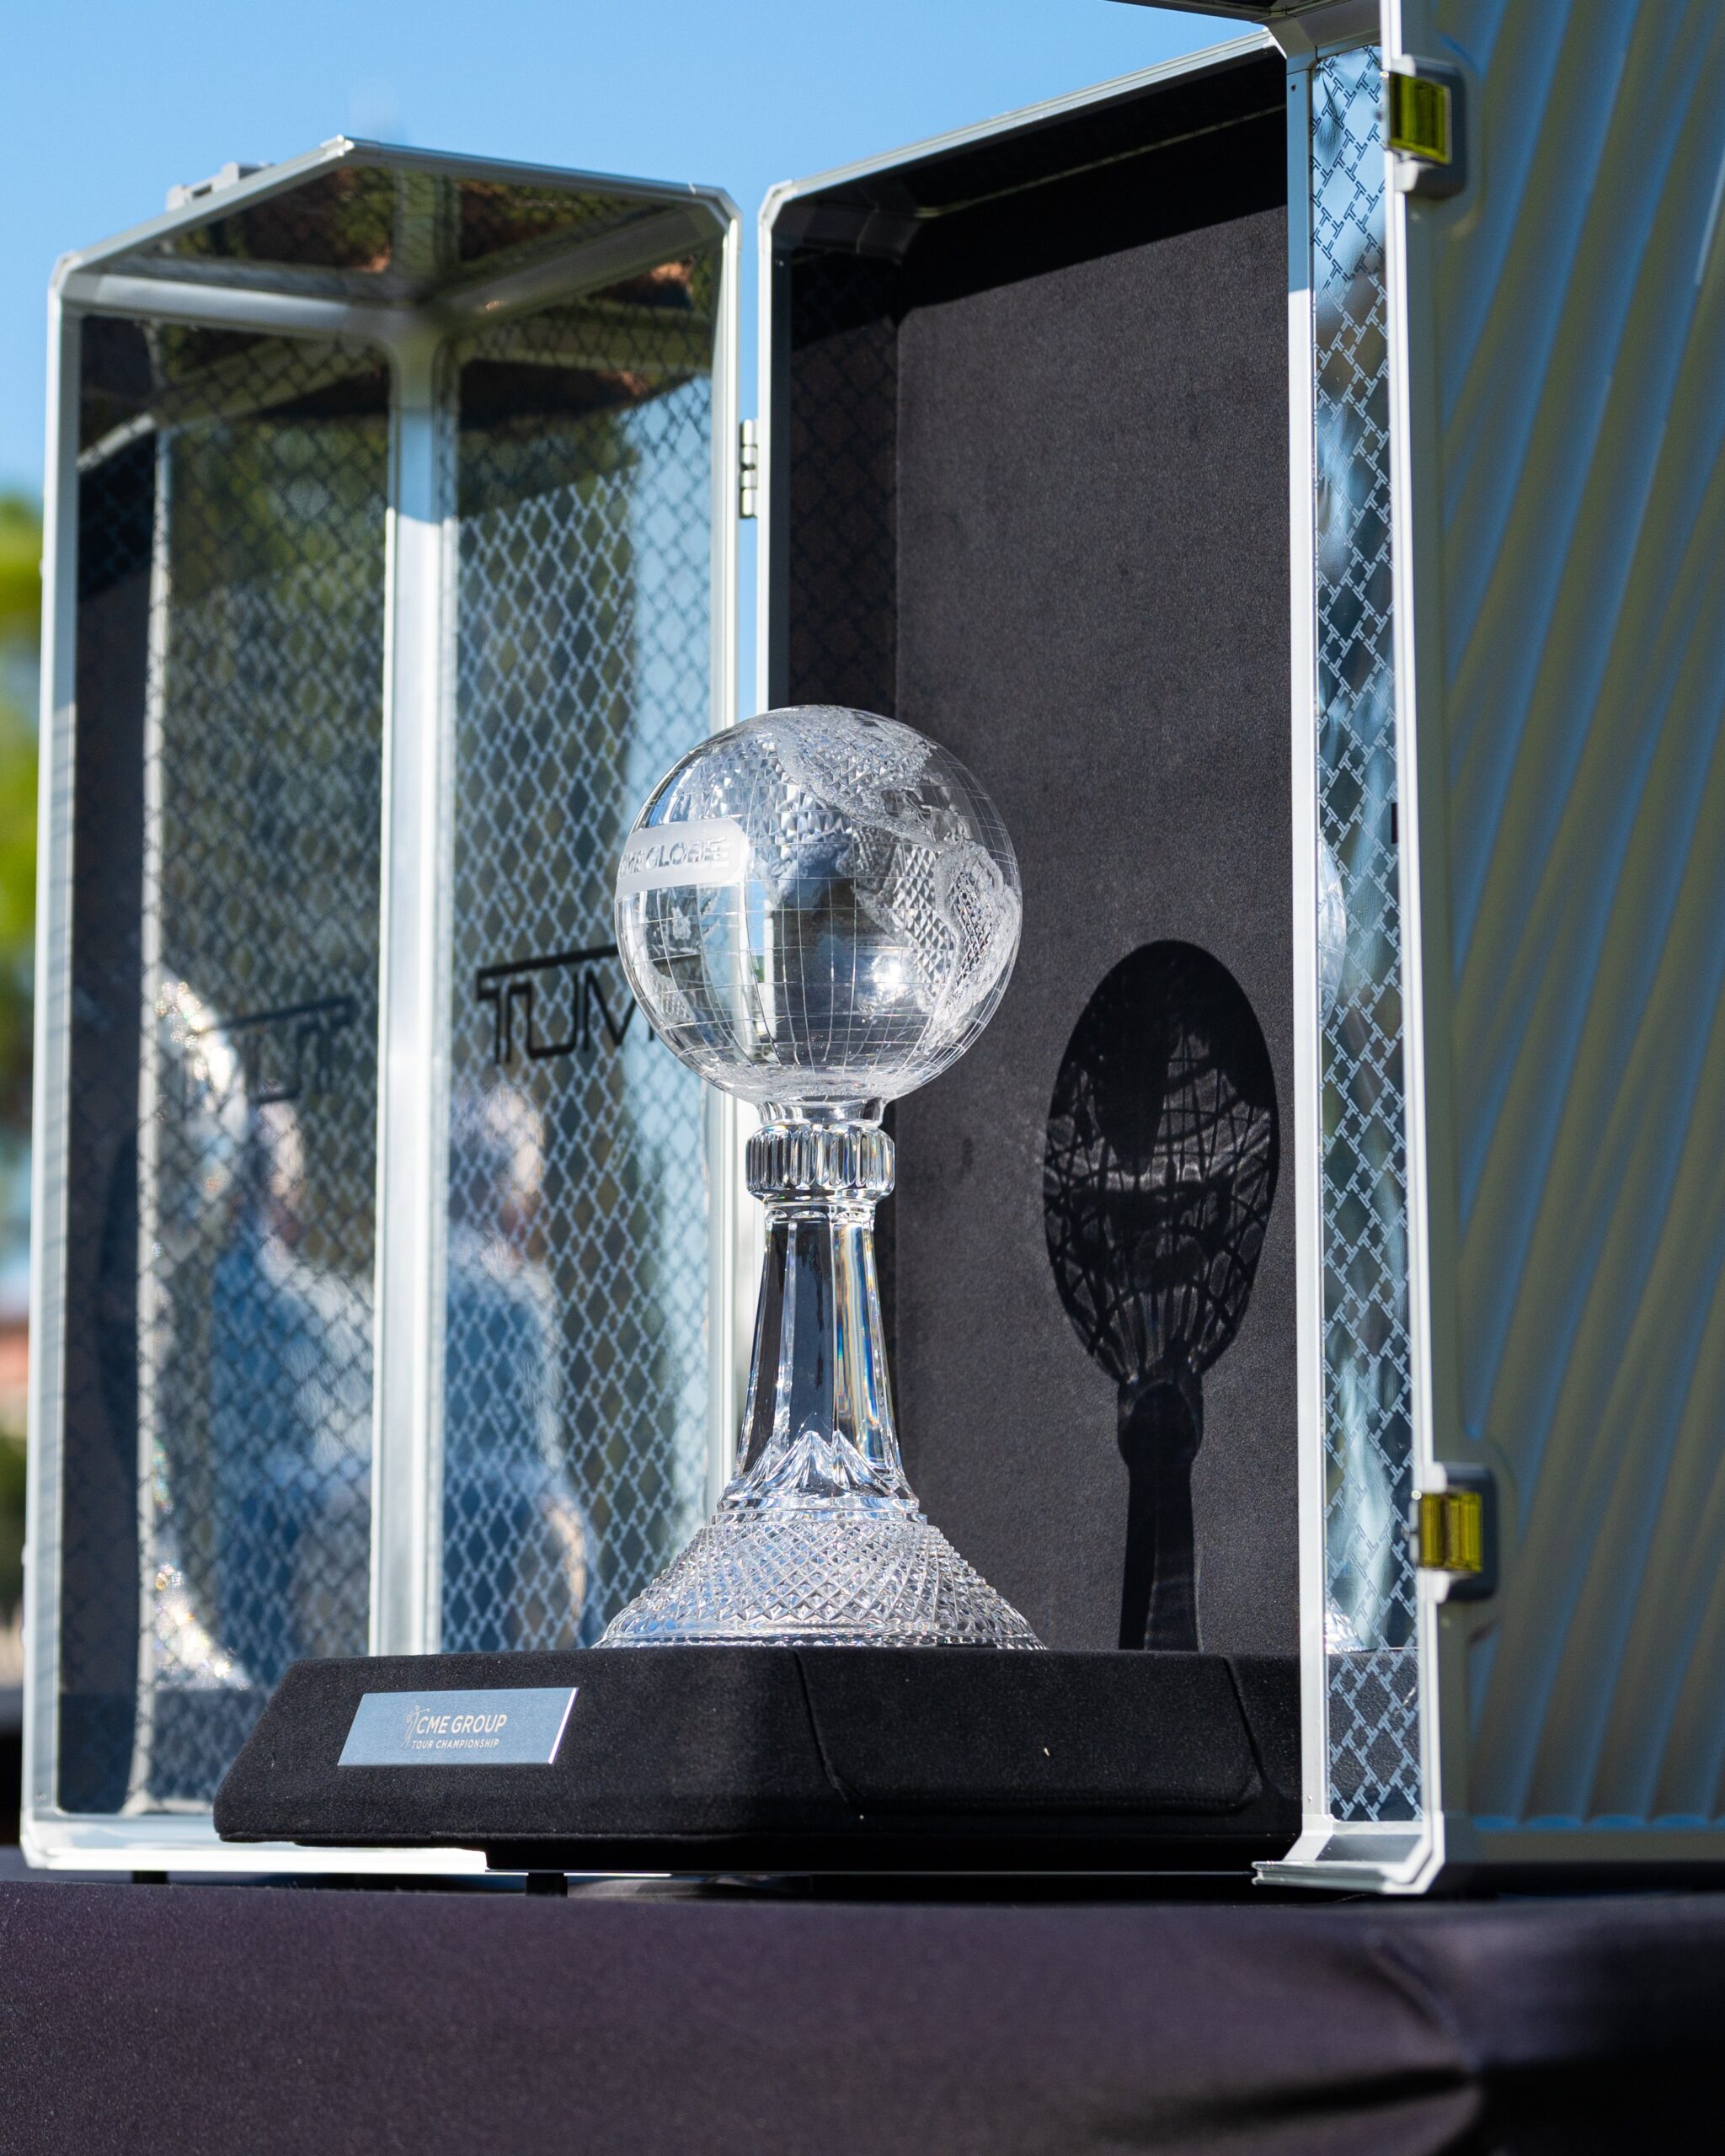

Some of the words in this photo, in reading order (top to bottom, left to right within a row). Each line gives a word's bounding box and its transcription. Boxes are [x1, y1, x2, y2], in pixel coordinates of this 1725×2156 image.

[476, 942, 655, 1065] TUM
[416, 1715, 451, 1734] CME
[451, 1713, 508, 1734] GROUP
[412, 1739, 434, 1749] TOUR
[435, 1737, 499, 1749] CHAMPIONSHIP
